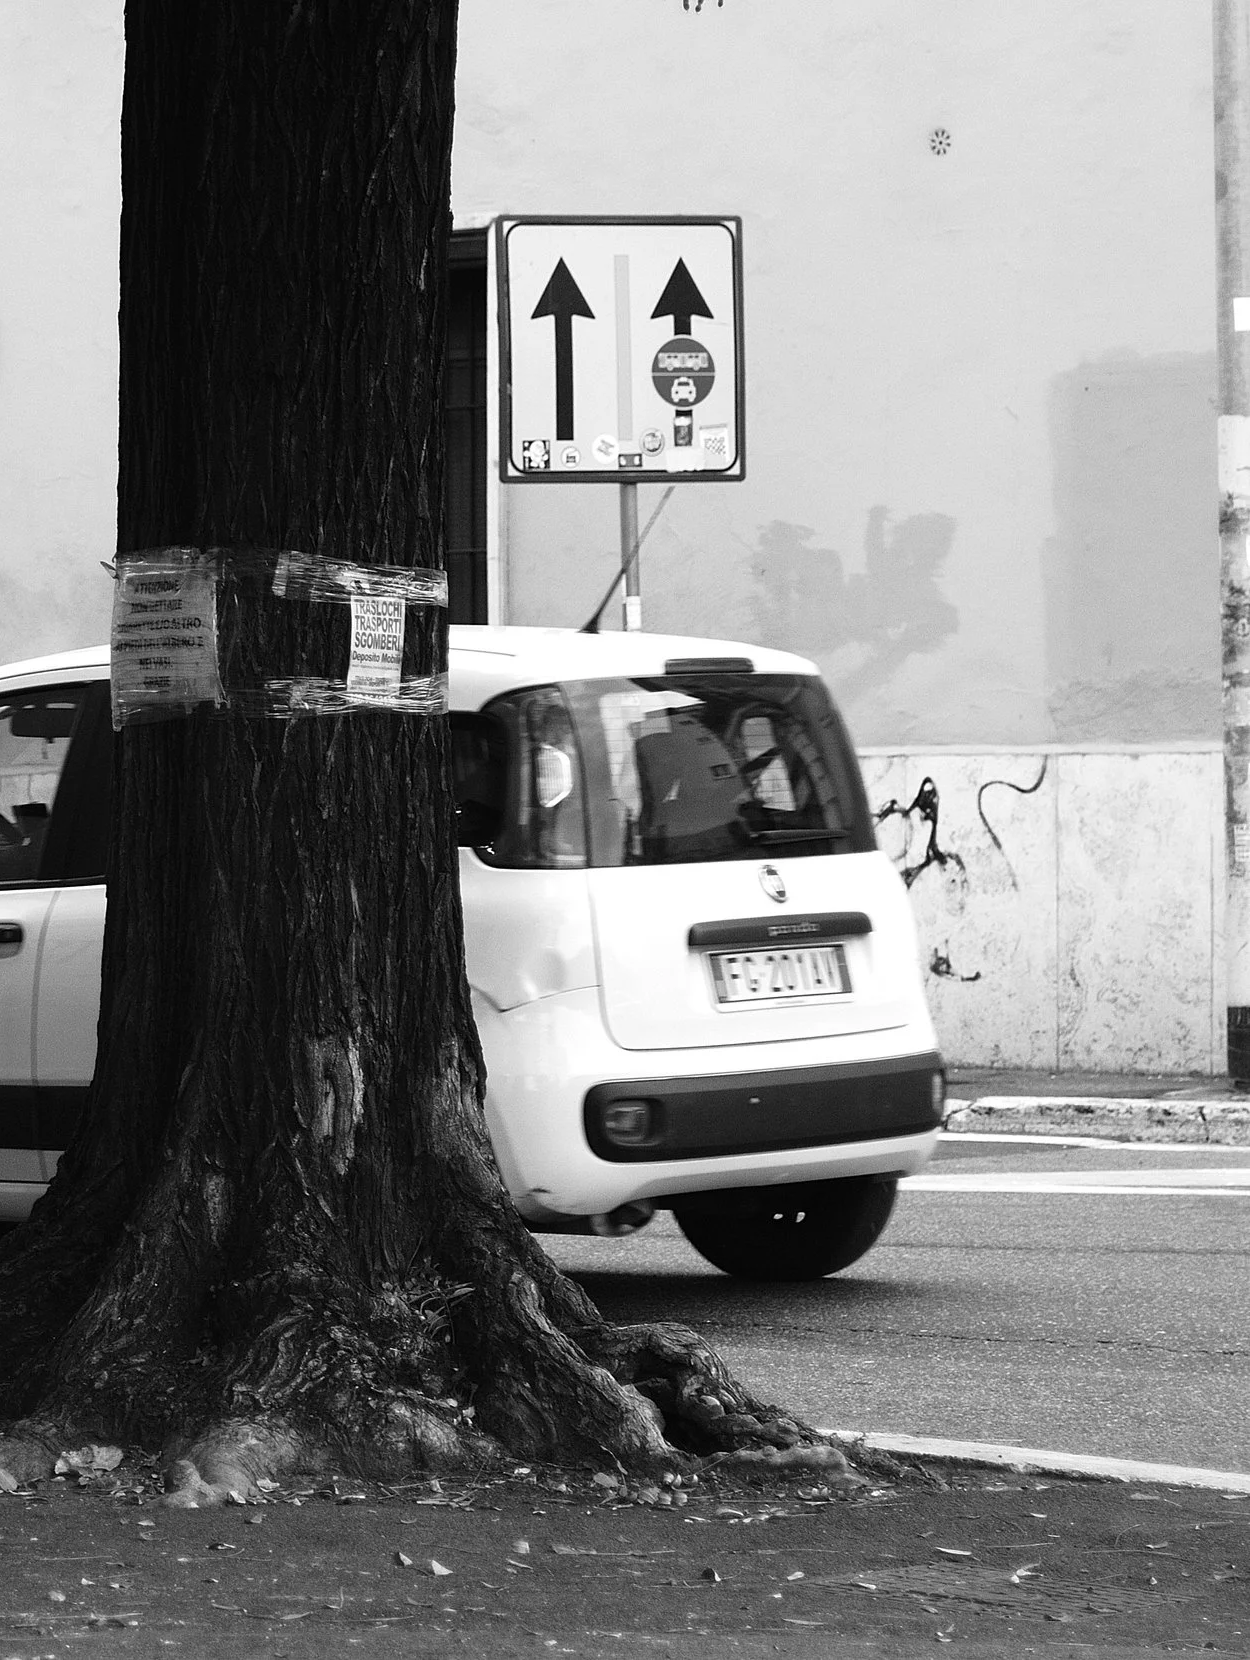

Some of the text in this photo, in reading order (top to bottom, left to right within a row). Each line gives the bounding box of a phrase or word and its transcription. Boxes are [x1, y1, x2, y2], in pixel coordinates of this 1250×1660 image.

[354, 599, 403, 618] TRASLOCHI
[354, 615, 402, 634] TRASPORTI
[354, 632, 400, 651] SGOMBERI
[352, 650, 380, 663] Deposito
